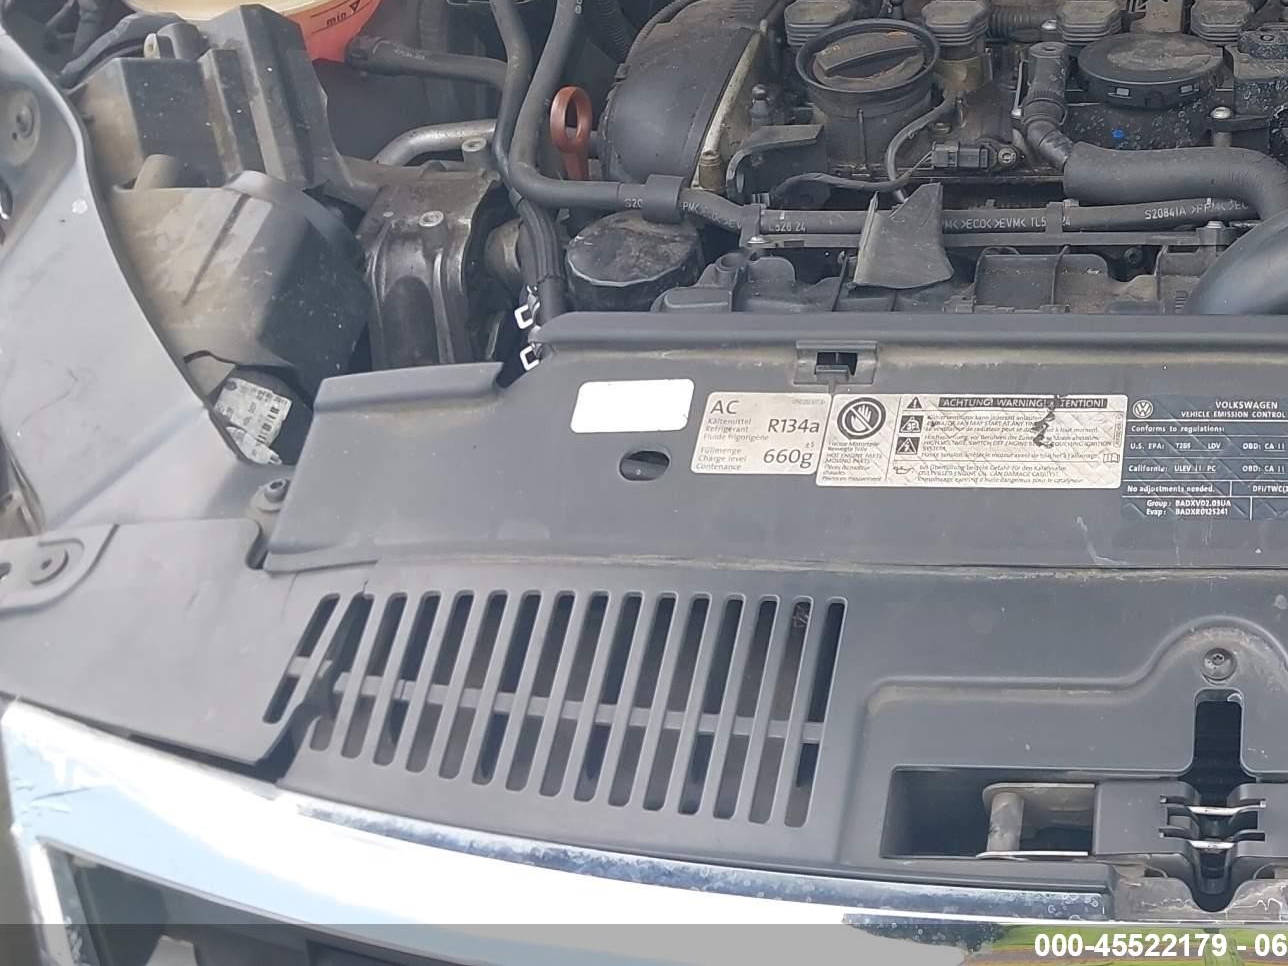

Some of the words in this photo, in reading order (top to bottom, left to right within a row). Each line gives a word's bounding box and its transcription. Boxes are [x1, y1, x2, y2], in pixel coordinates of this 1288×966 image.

[326, 12, 346, 27] min
[710, 400, 740, 414] AC
[942, 398, 994, 406] ACHTUNG!
[996, 398, 1046, 407] WARNING!
[768, 418, 820, 433] R134a
[763, 448, 812, 469] 660g
